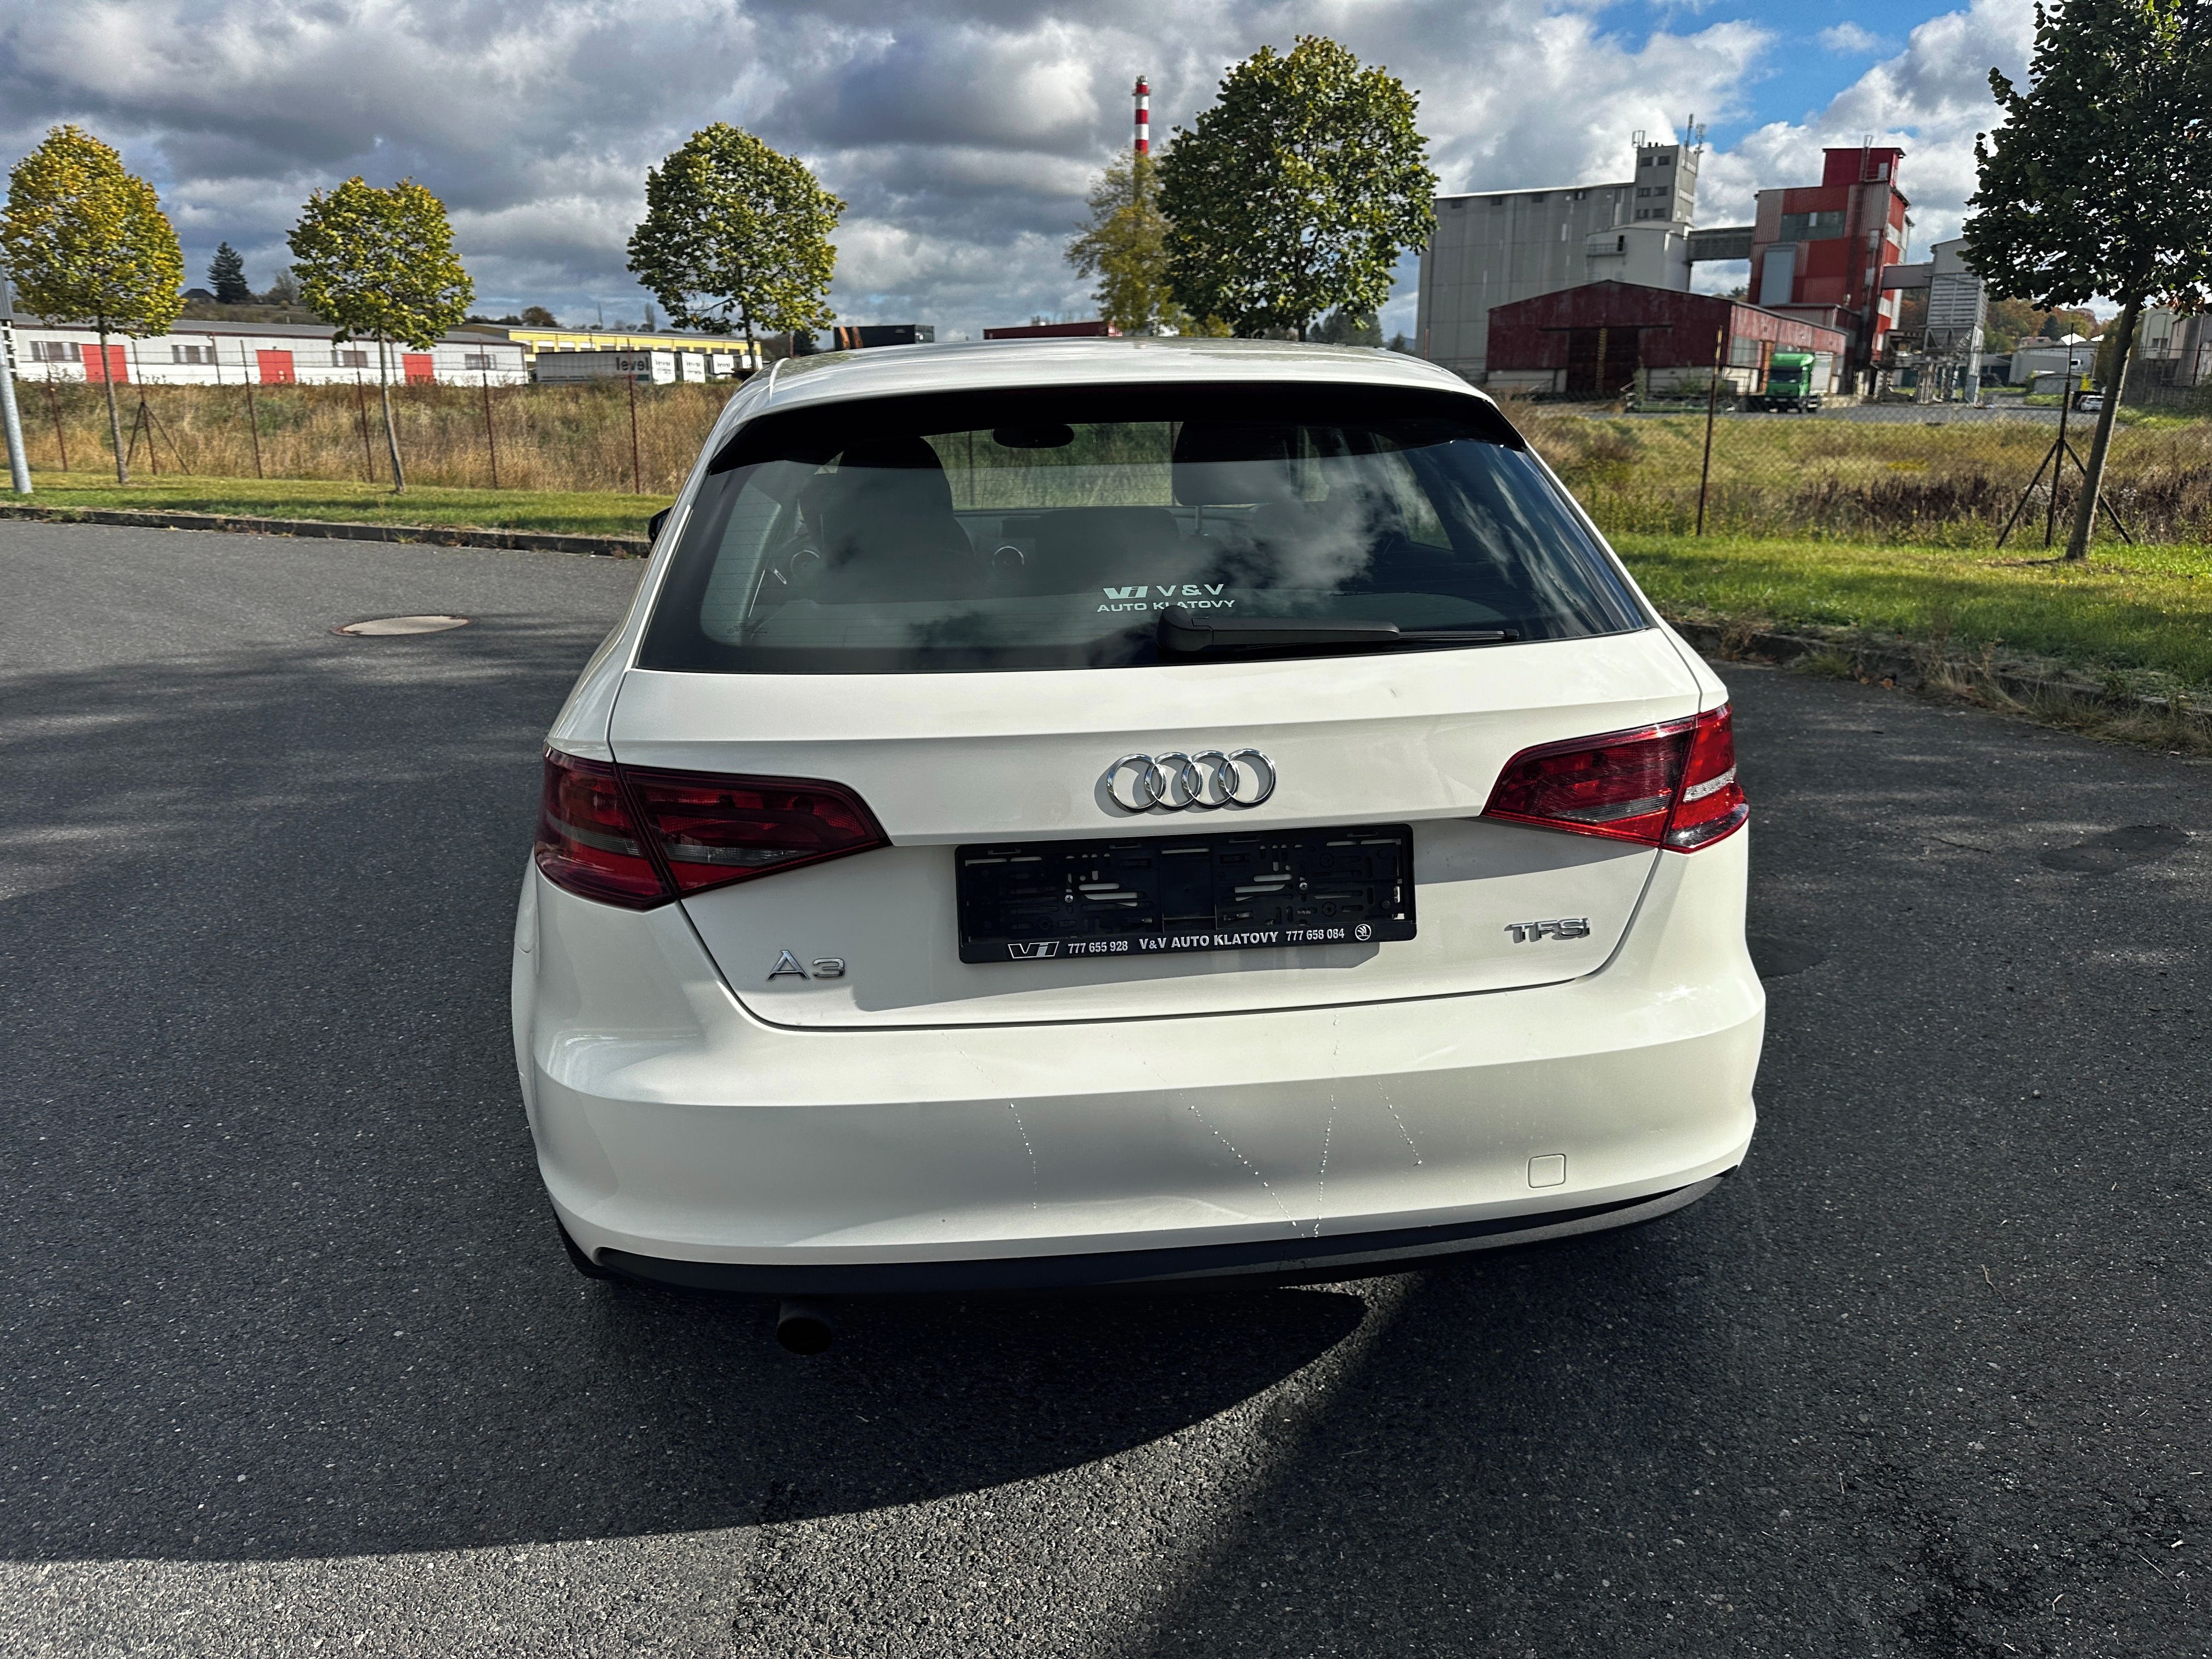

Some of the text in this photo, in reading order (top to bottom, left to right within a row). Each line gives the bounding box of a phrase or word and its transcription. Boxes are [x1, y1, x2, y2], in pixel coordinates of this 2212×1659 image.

[616, 357, 650, 370] level
[1097, 603, 1147, 612] AUTO
[1068, 943, 1086, 954] 777
[1088, 941, 1107, 953] 655
[1109, 940, 1128, 952] 928
[1139, 937, 1167, 950] V&V
[1171, 935, 1209, 948] AUTO
[1214, 932, 1278, 946] KLATOVY
[1285, 930, 1304, 941] 777
[1306, 929, 1324, 940] 658
[1327, 928, 1345, 939] 084
[1509, 917, 1590, 941] TFSI
[766, 950, 845, 981] A3
